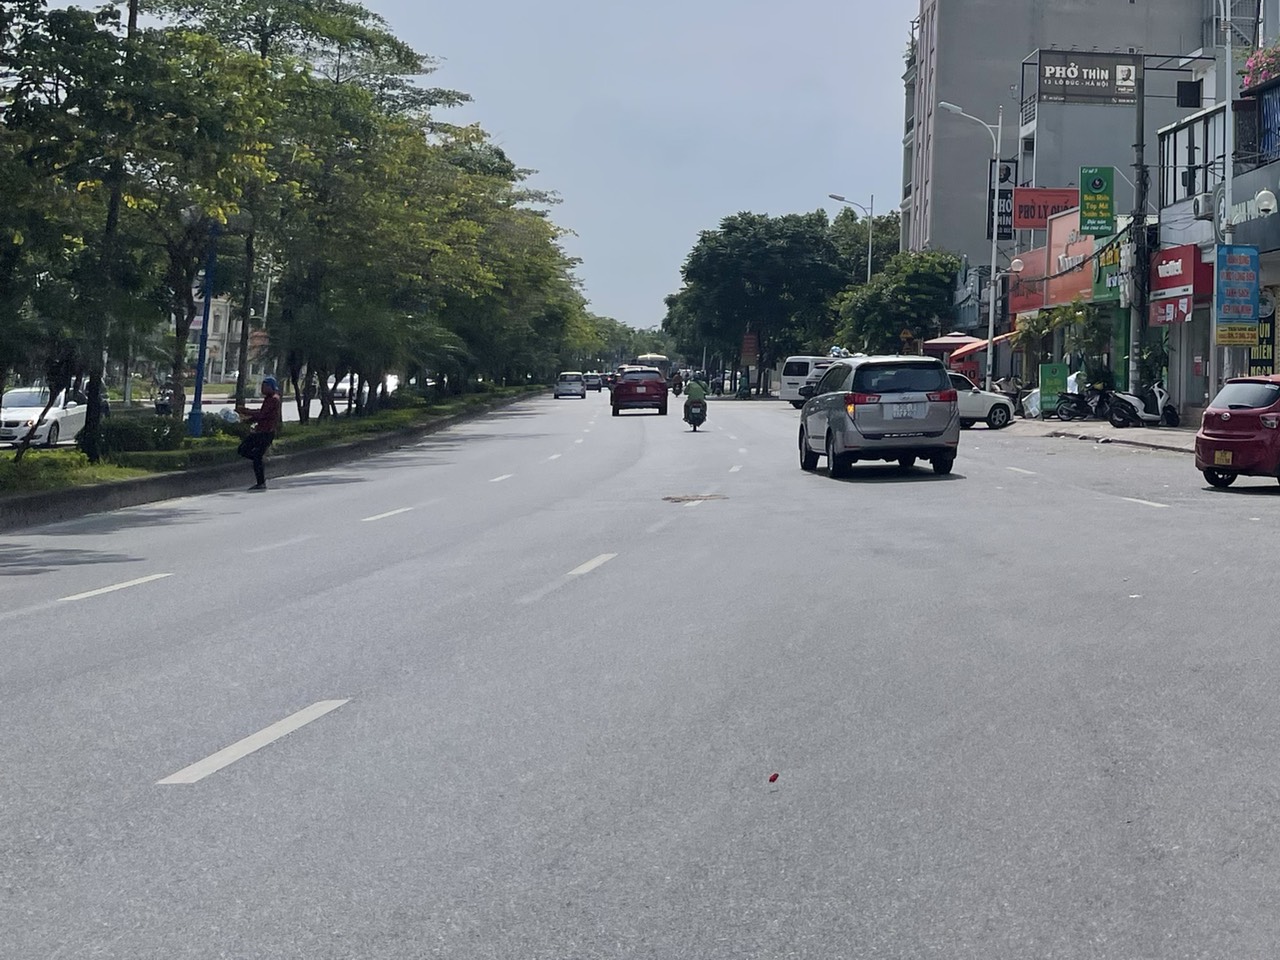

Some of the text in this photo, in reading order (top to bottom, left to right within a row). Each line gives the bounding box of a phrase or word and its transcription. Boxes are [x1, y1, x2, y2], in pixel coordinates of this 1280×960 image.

[1045, 62, 1109, 80] PHỞ THÌN
[1018, 199, 1036, 219] PHỞ
[1038, 201, 1049, 218] LÝ
